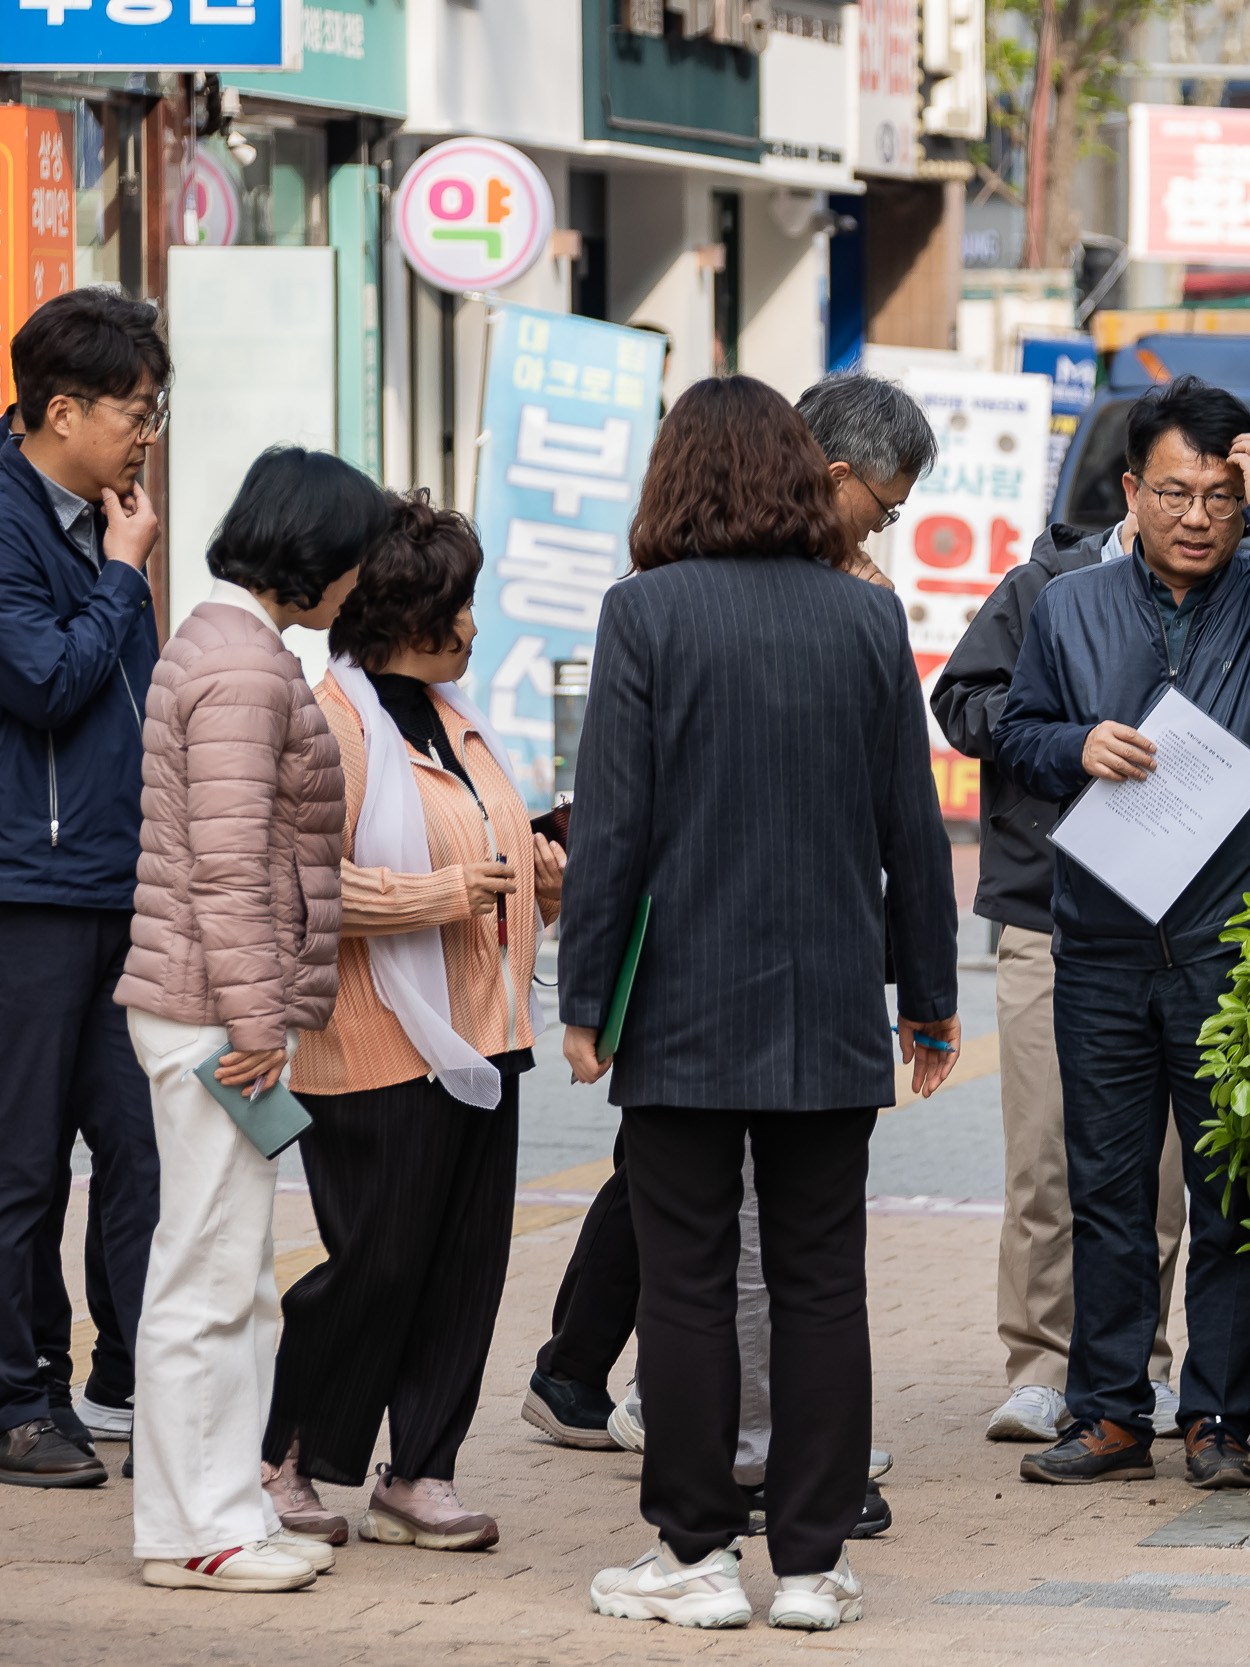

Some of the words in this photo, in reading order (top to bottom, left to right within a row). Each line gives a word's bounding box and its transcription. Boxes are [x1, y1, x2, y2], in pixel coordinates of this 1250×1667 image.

[38, 130, 63, 182] 삼성
[31, 187, 69, 238] 래미안
[429, 178, 511, 259] 약
